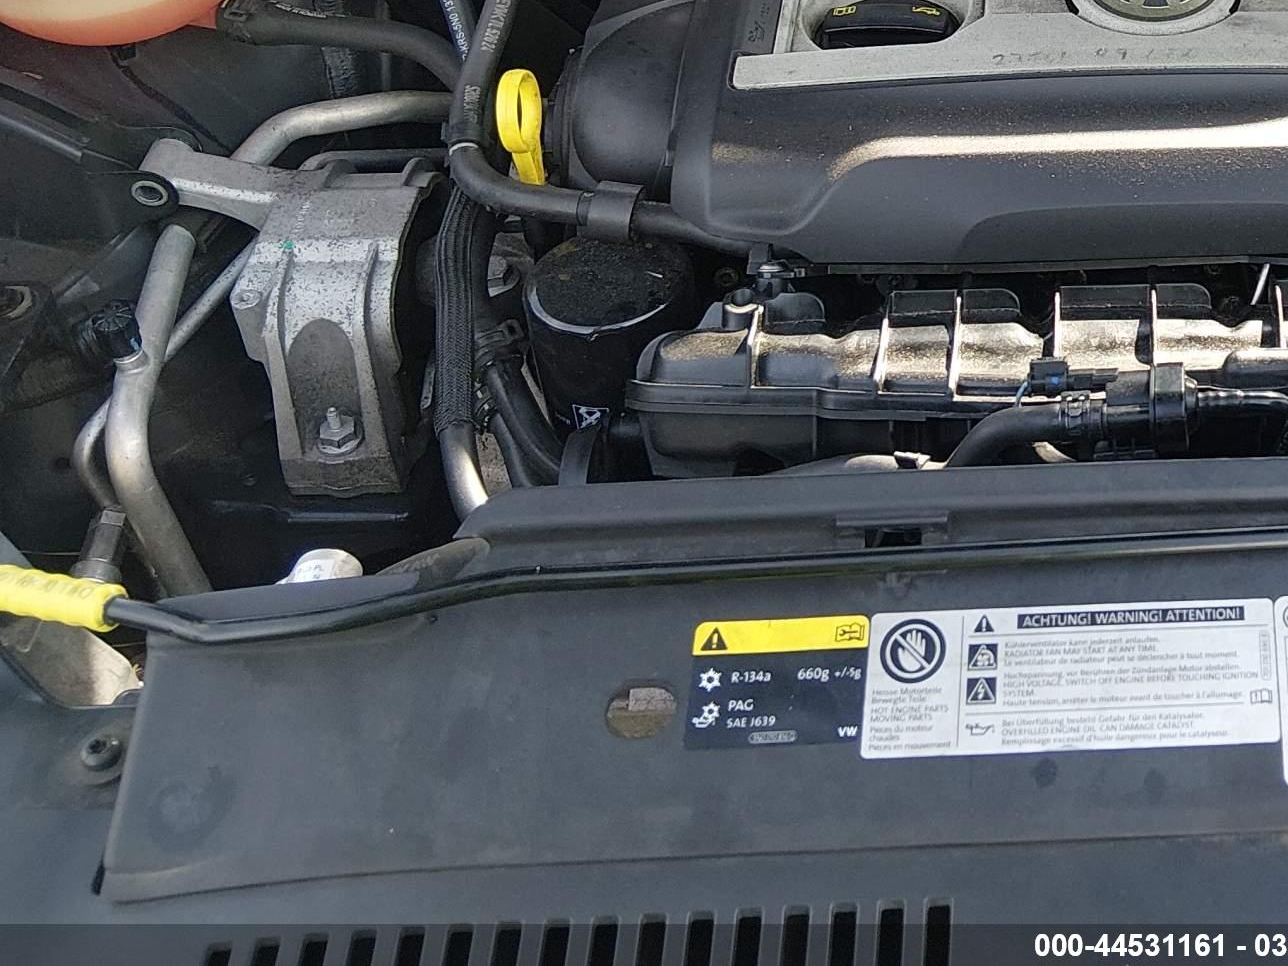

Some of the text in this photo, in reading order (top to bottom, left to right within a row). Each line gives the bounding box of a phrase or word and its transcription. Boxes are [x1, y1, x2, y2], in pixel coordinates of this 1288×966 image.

[1022, 606, 1240, 628] ACHTUNG! WARNING! ATTENTION!
[731, 670, 771, 684] R-134a
[797, 667, 829, 682] 660g
[727, 698, 754, 712] PAG
[726, 717, 747, 729] SAE
[837, 726, 858, 737] VW
